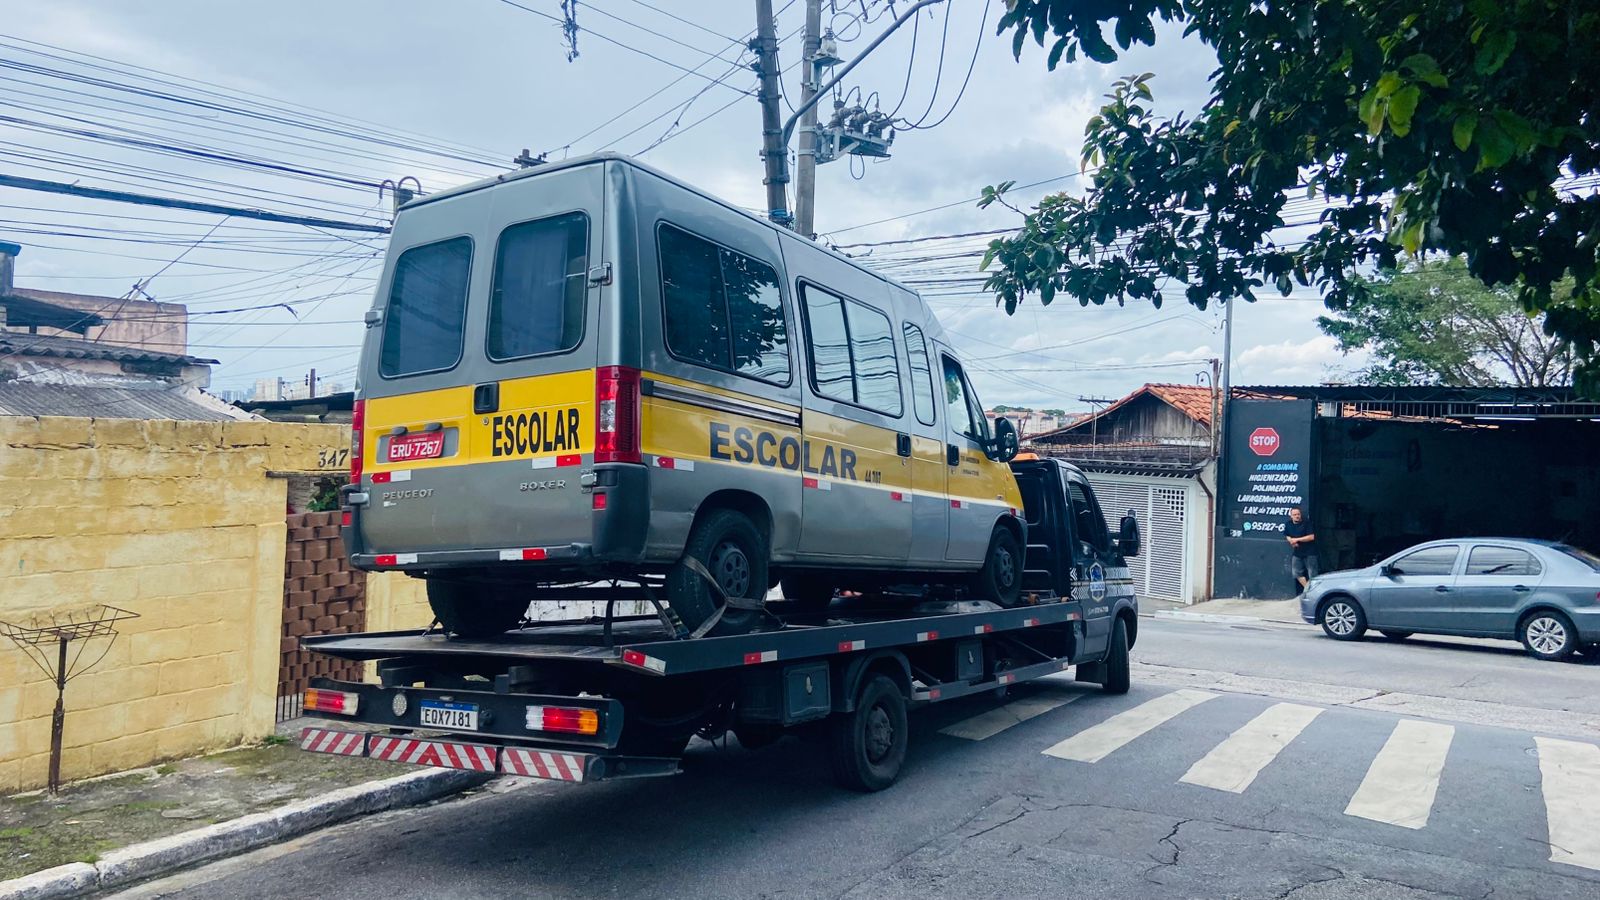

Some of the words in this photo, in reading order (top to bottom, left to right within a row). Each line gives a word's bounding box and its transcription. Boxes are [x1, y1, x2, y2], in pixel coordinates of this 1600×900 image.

[492, 408, 580, 457] ESCOLAR
[1252, 436, 1276, 446] STOP
[708, 421, 857, 481] ESCOLAR
[318, 448, 349, 468] 347
[1262, 463, 1298, 471] COMBINAR
[1248, 473, 1298, 483] HIGIENIZAÇÃO
[519, 479, 566, 491] BOXER
[383, 488, 434, 500] PEUGEOT
[1275, 496, 1302, 504] MOTOR
